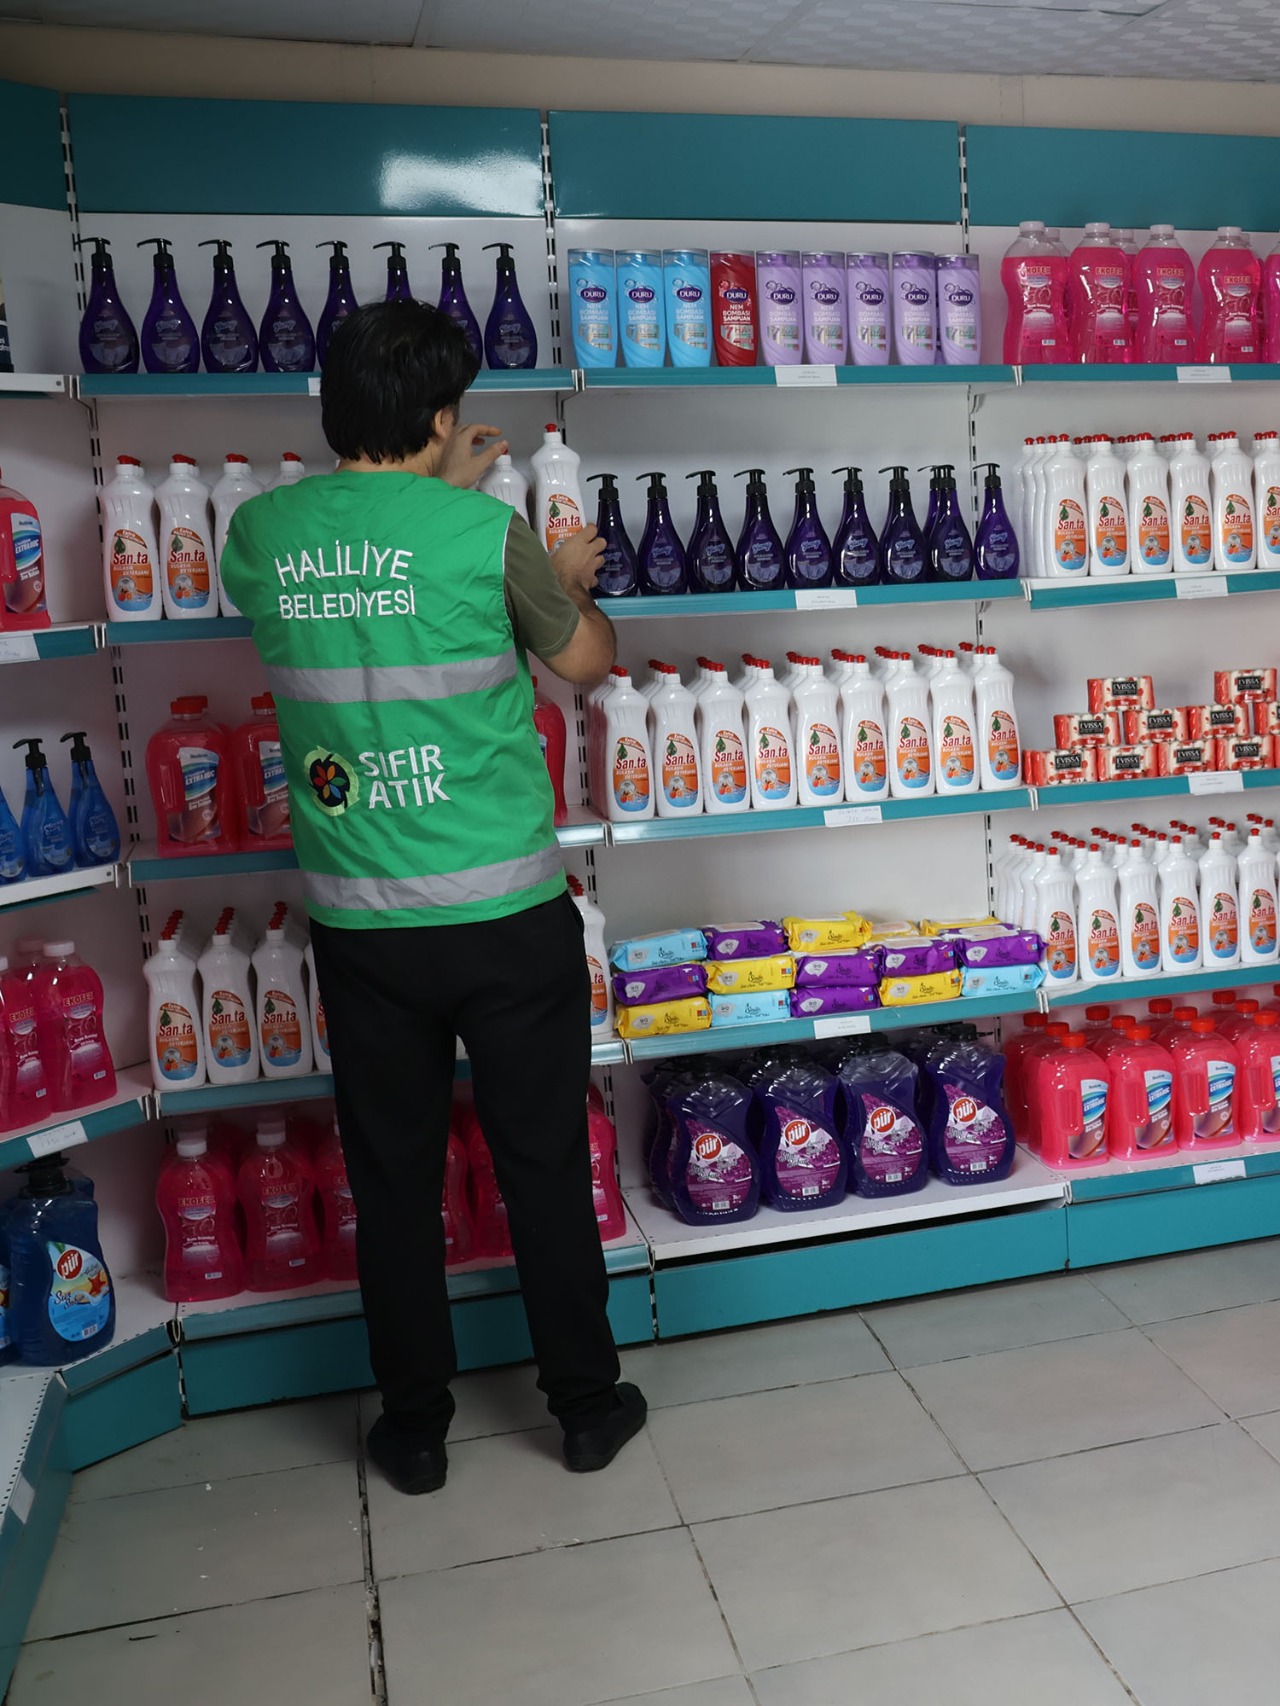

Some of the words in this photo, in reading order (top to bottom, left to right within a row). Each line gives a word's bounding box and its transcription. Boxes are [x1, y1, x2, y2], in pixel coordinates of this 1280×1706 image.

[583, 290, 604, 298] DURU
[632, 291, 653, 299] DURU
[680, 290, 700, 298] DURU
[726, 292, 747, 300] DURU
[773, 292, 793, 300] DURU
[818, 292, 837, 300] DURU
[907, 293, 927, 301] DURU
[275, 540, 413, 586] HALİLİYE
[278, 585, 416, 619] BELEDİYESİ
[359, 745, 444, 777] SIFIR
[369, 773, 451, 809] ATIK
[871, 1111, 894, 1130] pür
[953, 1102, 976, 1122] pür
[785, 1125, 810, 1145] pür
[695, 1137, 719, 1158] pür
[61, 1252, 79, 1278] pür
